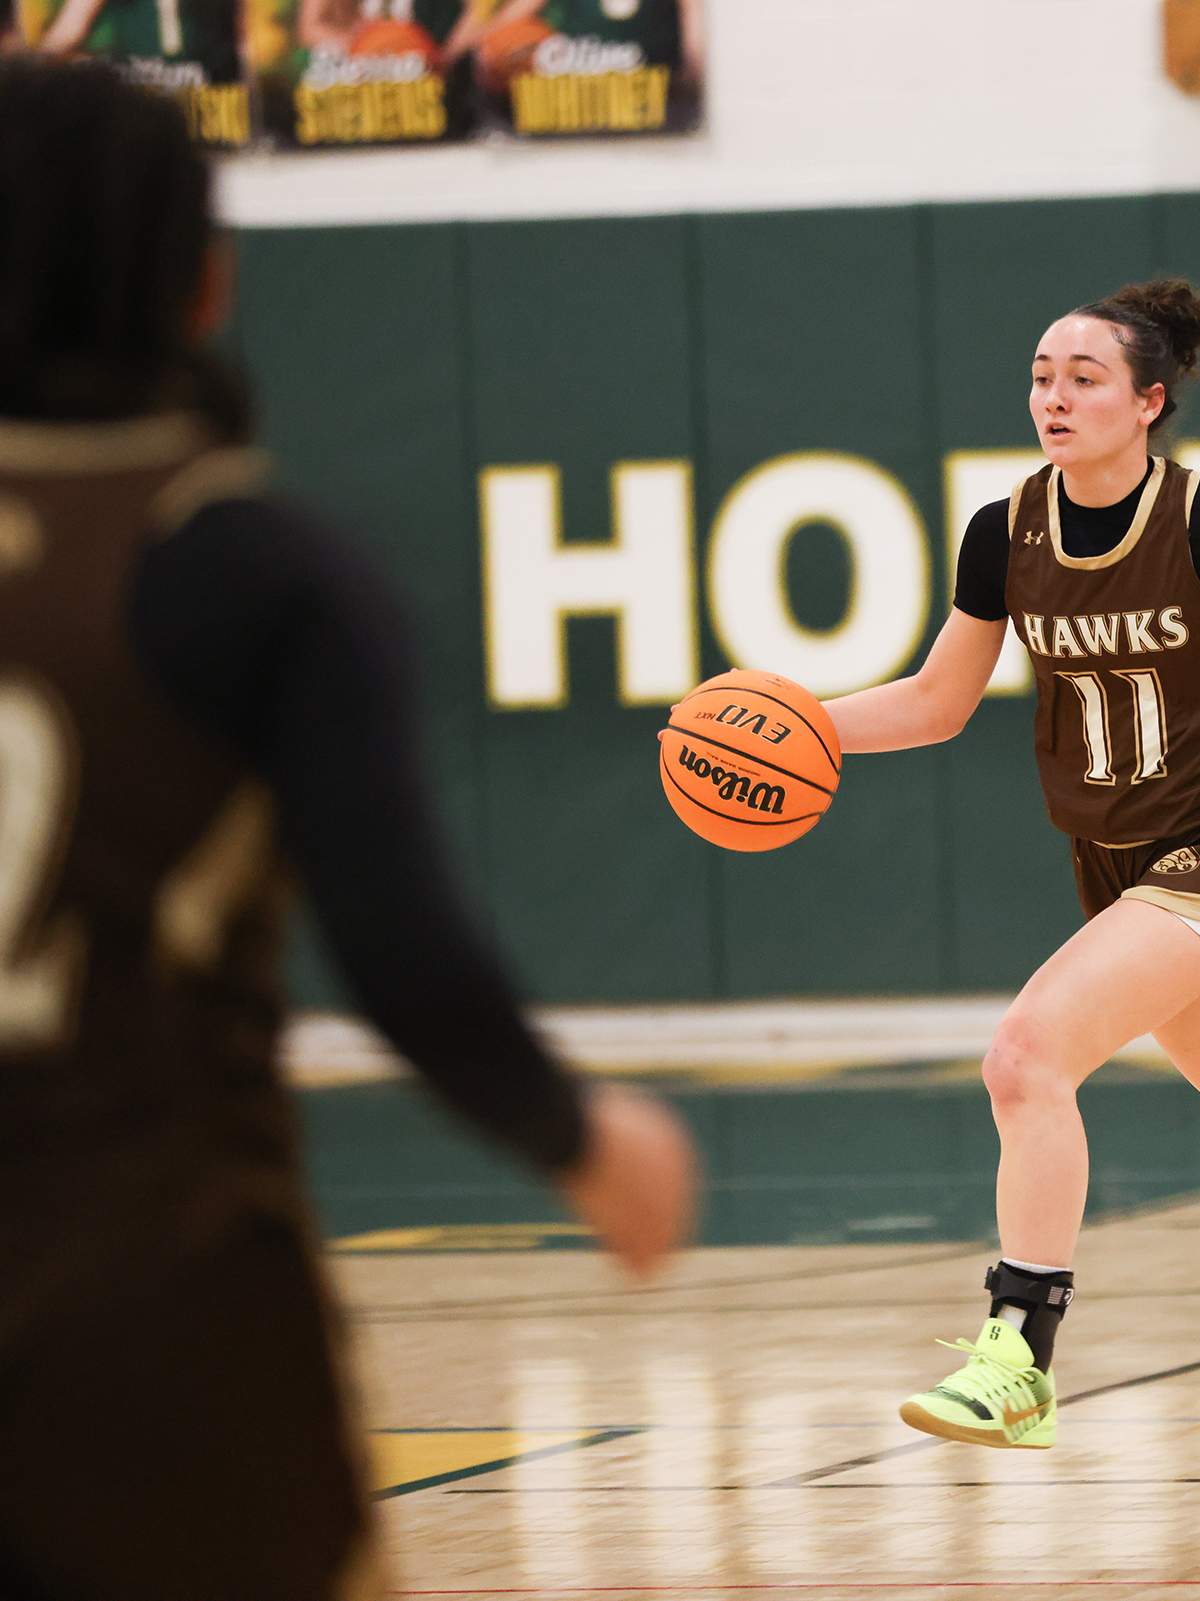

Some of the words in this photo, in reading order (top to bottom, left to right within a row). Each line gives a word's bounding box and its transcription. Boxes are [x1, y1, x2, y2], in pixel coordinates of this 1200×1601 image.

[294, 72, 446, 144] STEVENS
[511, 64, 669, 134] WHITNEY
[1022, 606, 1189, 659] HAWKS
[694, 711, 717, 720] NXT
[717, 704, 792, 744] EVO
[1053, 667, 1168, 787] 11
[678, 744, 786, 815] Wilson
